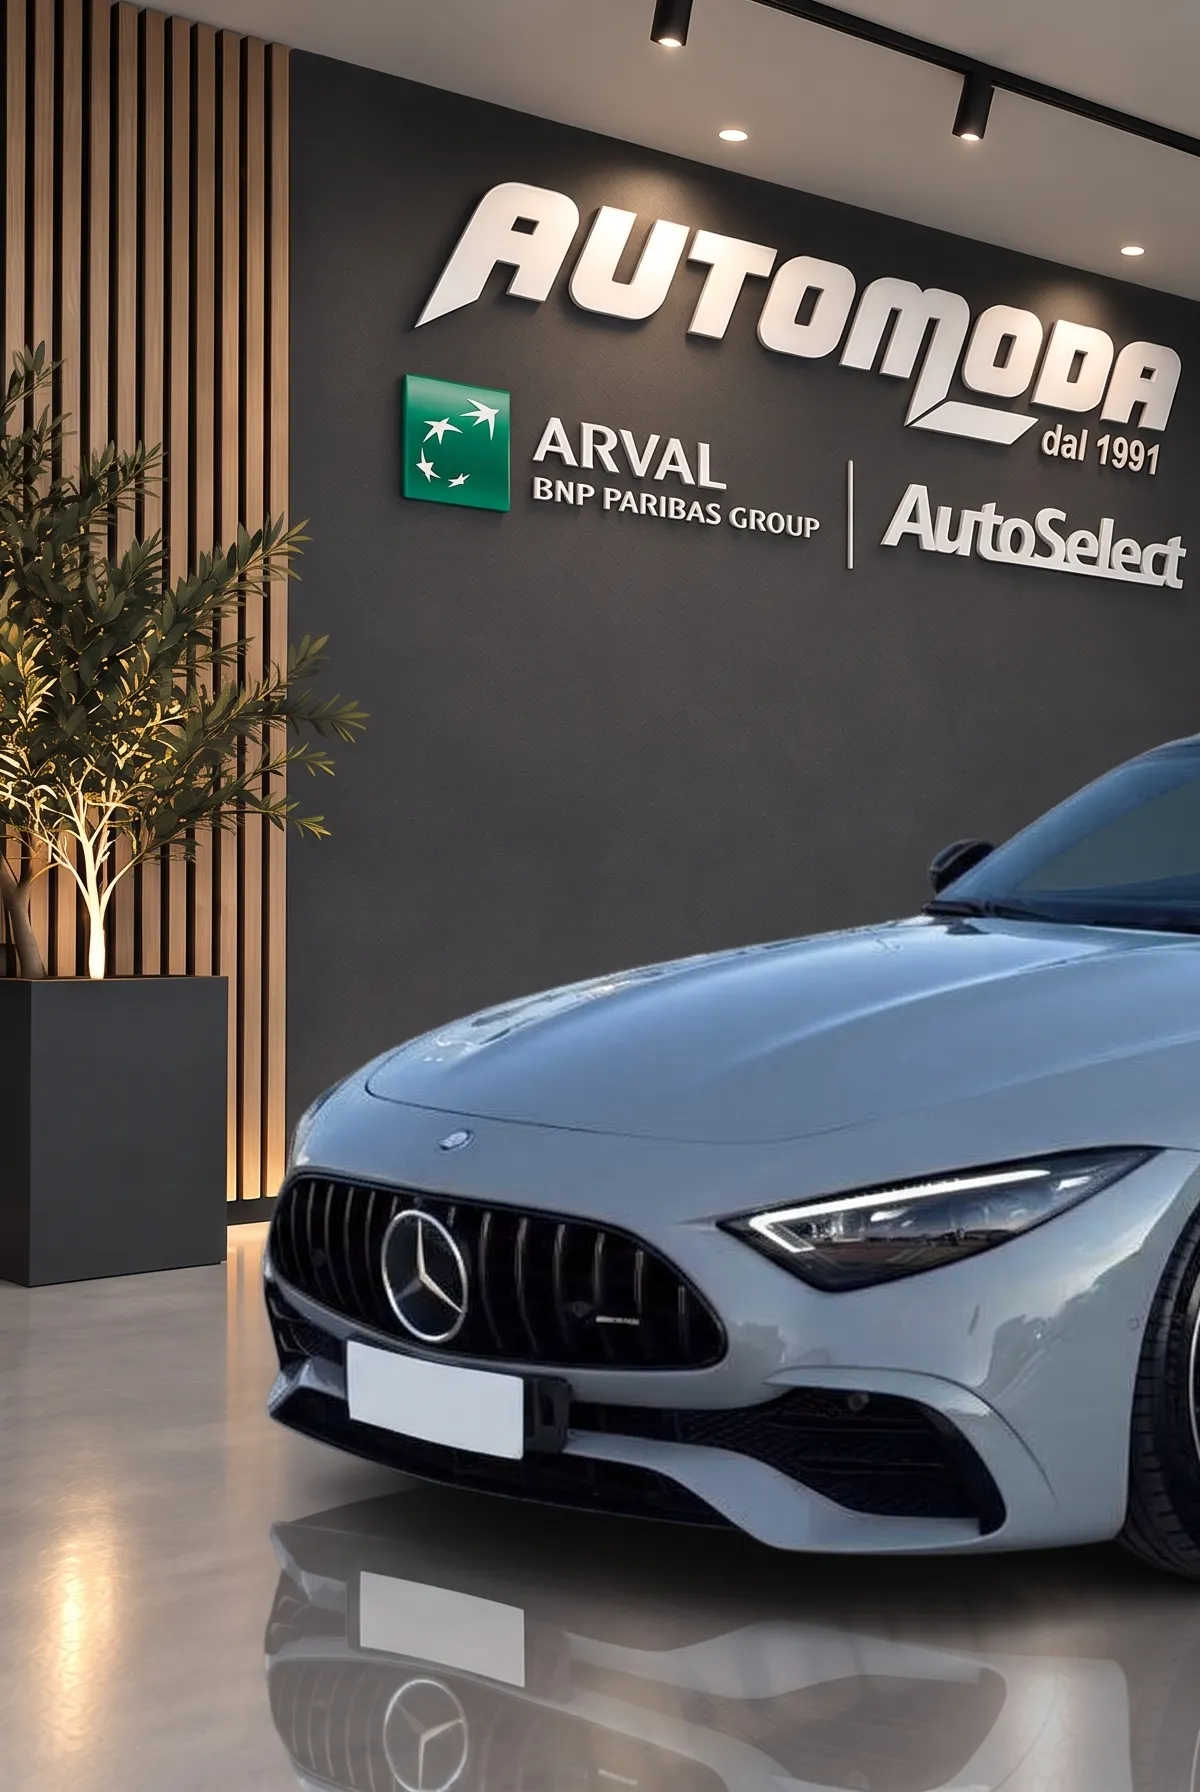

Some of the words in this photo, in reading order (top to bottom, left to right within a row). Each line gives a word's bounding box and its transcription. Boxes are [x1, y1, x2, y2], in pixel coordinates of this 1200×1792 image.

[413, 181, 1183, 444] AUTOMODA
[532, 416, 728, 491] ARVAL
[1041, 424, 1089, 461] dal
[1096, 434, 1161, 475] 1991
[532, 476, 596, 507] BNP
[602, 486, 722, 526] PARIBAS
[728, 506, 821, 539] GROUP
[880, 483, 1188, 589] AutoSelect
